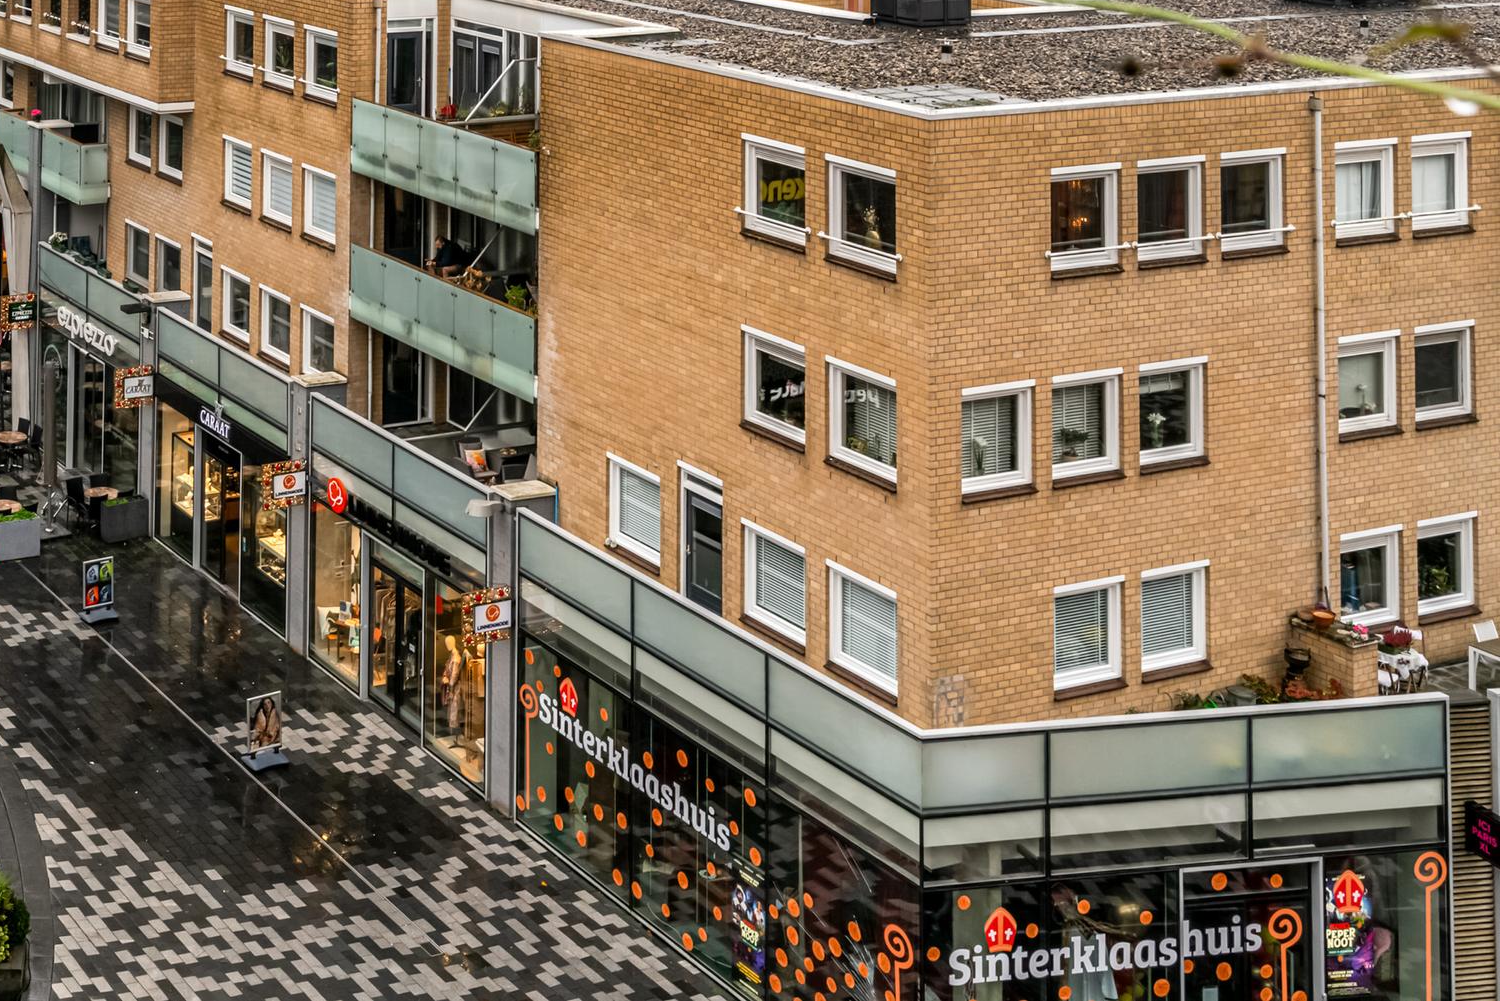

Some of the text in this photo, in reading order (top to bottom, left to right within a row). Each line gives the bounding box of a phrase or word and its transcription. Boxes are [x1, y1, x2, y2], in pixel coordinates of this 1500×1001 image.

[57, 306, 119, 357] ezprezzo
[125, 383, 152, 395] CARAAT
[200, 409, 231, 439] CARAAT
[538, 693, 731, 852] Sinterklaashuis
[1477, 819, 1491, 833] ICI
[1471, 825, 1498, 848] PARIS
[1479, 842, 1491, 856] XL
[1326, 927, 1356, 940] PEPER
[1327, 936, 1355, 949] NOOT
[948, 914, 1263, 986] Sinterklaashuis
